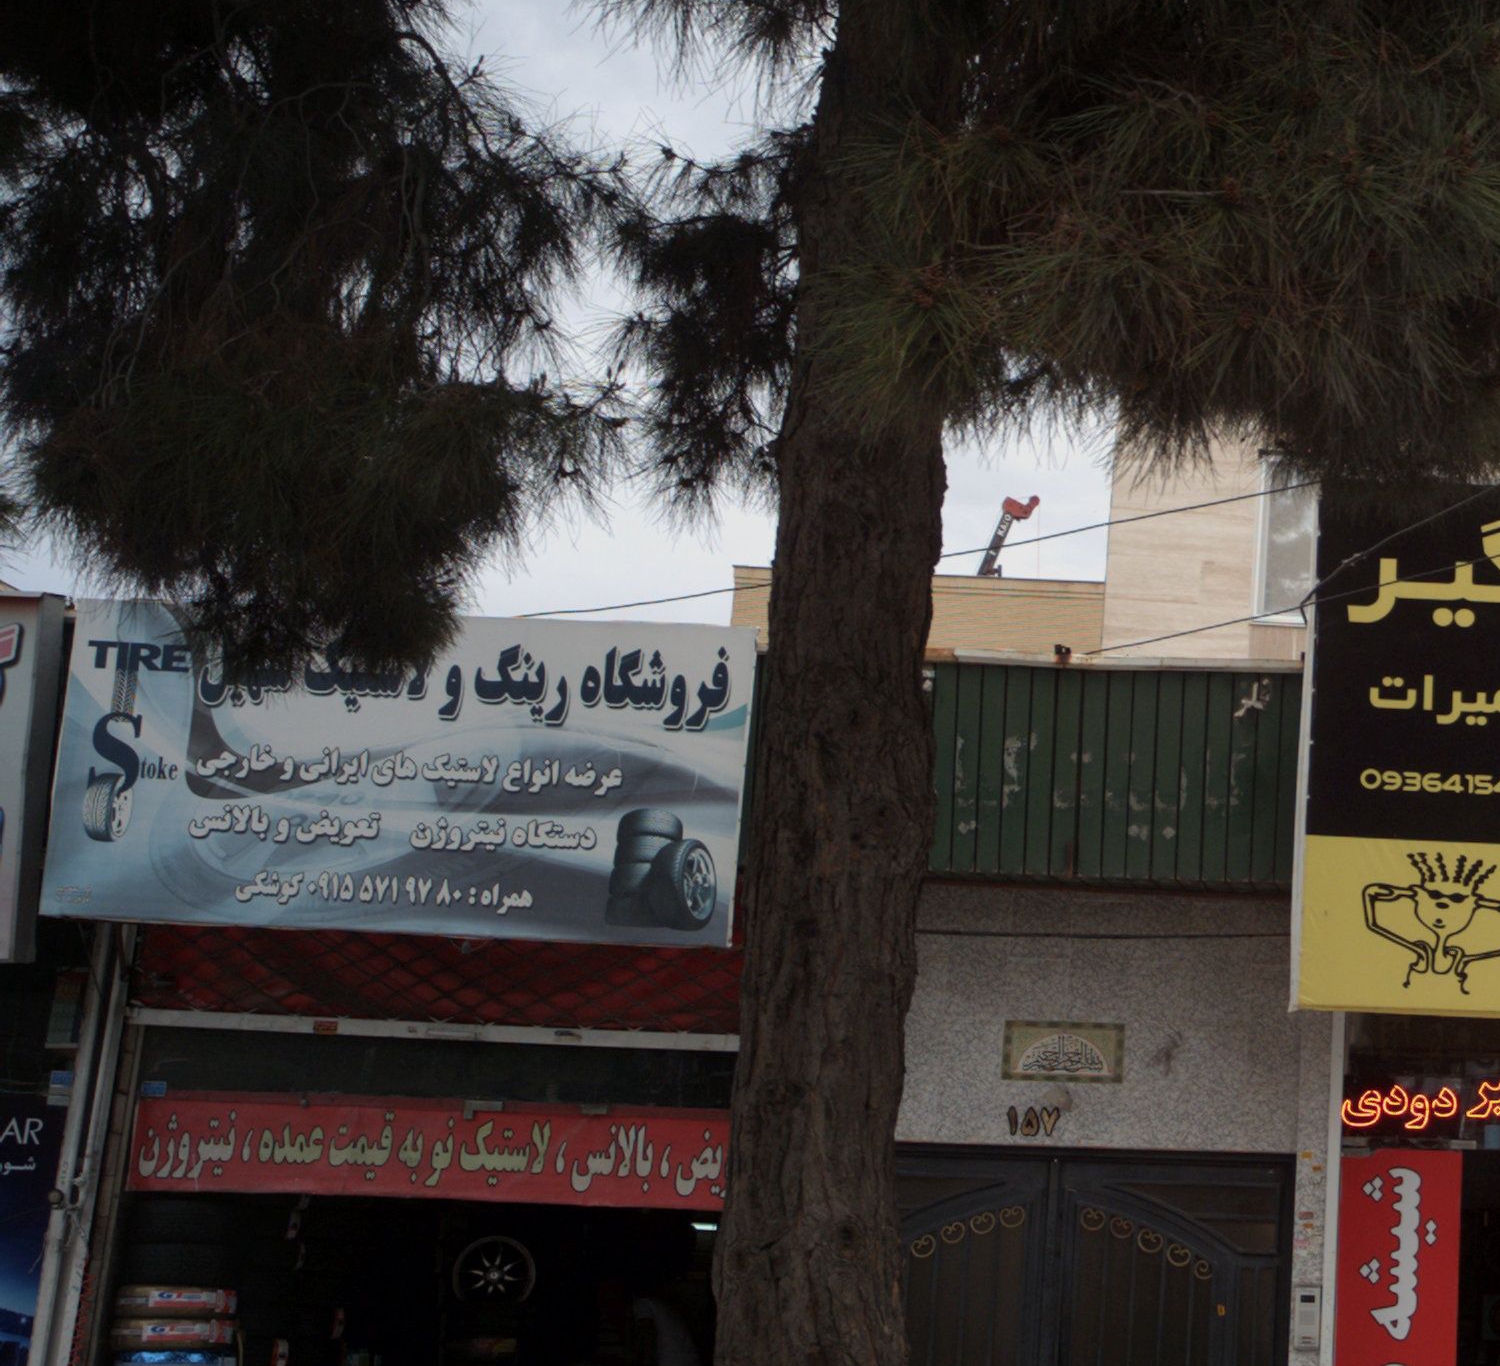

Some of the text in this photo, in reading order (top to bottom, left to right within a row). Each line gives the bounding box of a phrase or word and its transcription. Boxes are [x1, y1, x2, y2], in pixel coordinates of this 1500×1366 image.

[88, 639, 193, 673] TIRE
[436, 664, 465, 721] و
[474, 643, 572, 727] رینگ
[580, 646, 732, 731] فروشگاه
[195, 745, 623, 796] عرضه انواع لاستیک های ایرانی و خارجی
[188, 806, 598, 852] دستگاه نیتروژن تعویض و بالانس
[235, 870, 305, 904] کوشکی
[1006, 1106, 1061, 1137] ۱۵۷
[1341, 1084, 1458, 1130] دودی
[138, 1110, 236, 1179] نیتروژن
[328, 1110, 396, 1181] قیمت
[398, 1127, 424, 1184] به
[424, 1117, 455, 1186] نو
[459, 1119, 551, 1186] لاستیک
[1359, 1167, 1439, 1341] شیشه
